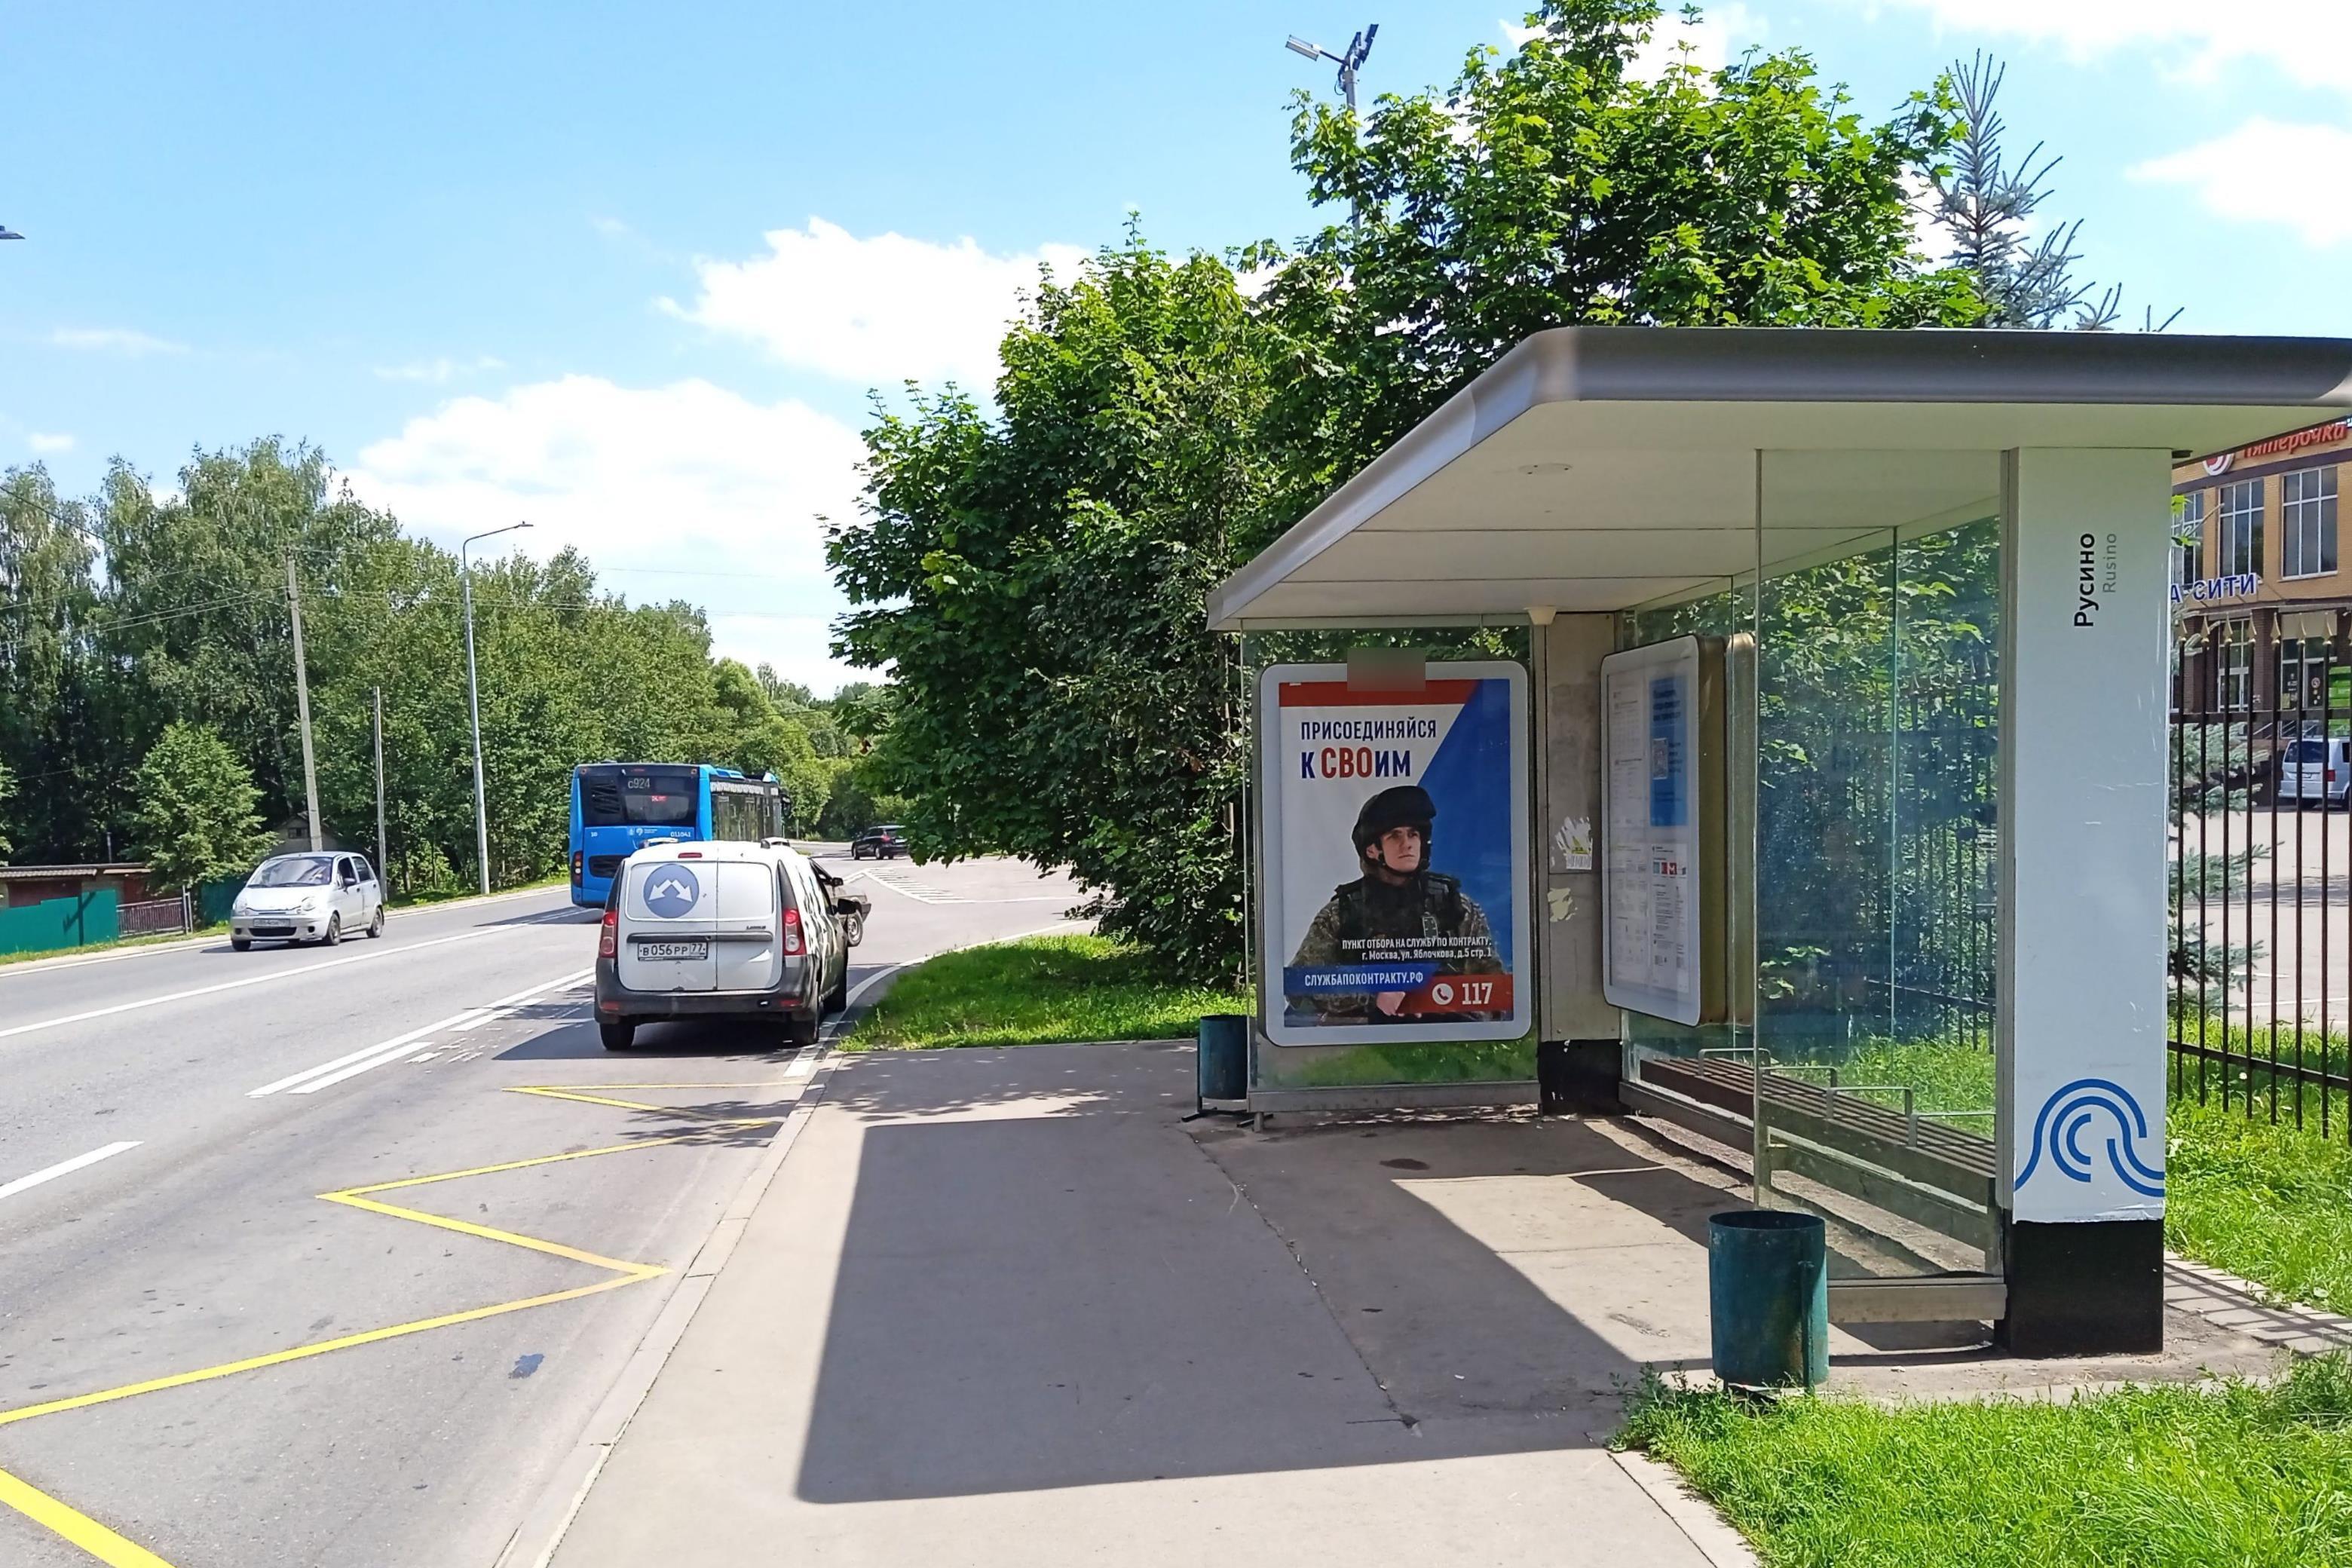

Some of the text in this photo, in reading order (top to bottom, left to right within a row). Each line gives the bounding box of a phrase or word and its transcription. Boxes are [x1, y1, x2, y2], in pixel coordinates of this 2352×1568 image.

[2102, 533, 2117, 593] Rusino
[2073, 533, 2099, 626] Русино
[2192, 572, 2257, 602] СИТИ
[1301, 716, 1436, 741] ПРИСОЕДИНЯЙСЯ
[1301, 752, 1315, 779] К
[1342, 936, 1492, 950] ПУНКТ ОТБОРА НА СЛУЖБУ ПО КОНТРАКТУ:
[1413, 948, 1456, 960] Яблочкова,
[1471, 950, 1487, 960] стр.
[1487, 948, 1493, 957] 1
[1305, 971, 1423, 987] СЛУЖБАПОКОНТРАКТУ.РФ
[1461, 982, 1493, 1006] 117
